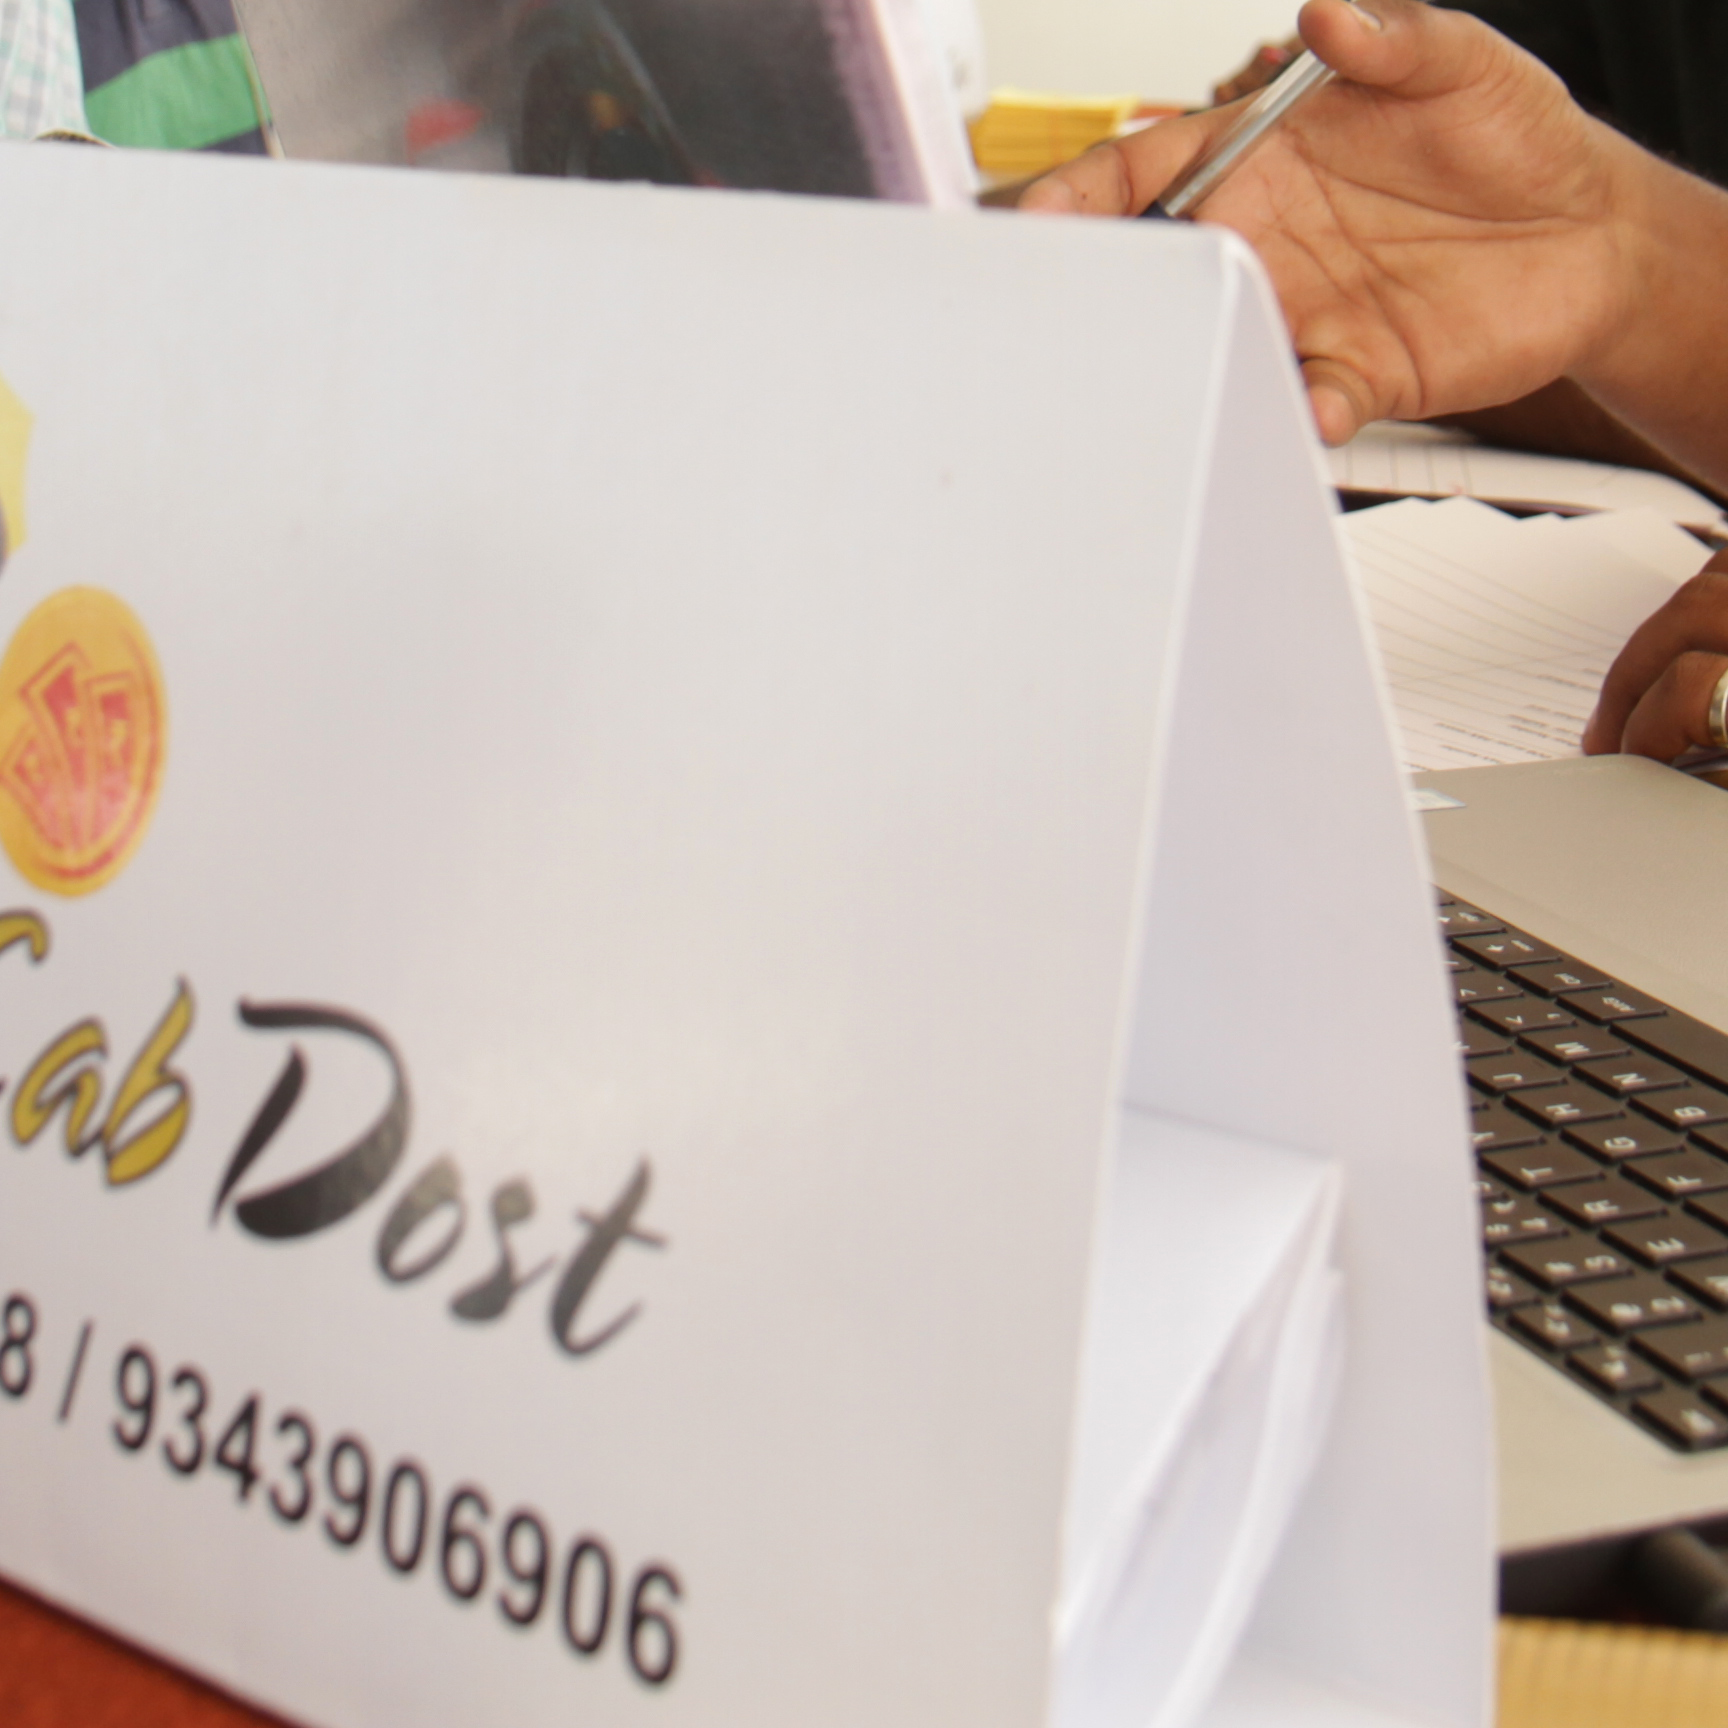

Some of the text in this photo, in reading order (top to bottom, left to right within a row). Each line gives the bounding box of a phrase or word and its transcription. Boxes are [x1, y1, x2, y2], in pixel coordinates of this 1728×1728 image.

[1555, 1041, 1590, 1055] M
[1612, 1073, 1647, 1085] N
[1674, 1106, 1706, 1120] B
[209, 995, 671, 1357] Dost
[1545, 1103, 1581, 1117] H
[1604, 1137, 1637, 1152] G
[1667, 1176, 1702, 1190] F
[1521, 1167, 1553, 1181] T
[1647, 1238, 1685, 1255] E
[57, 1319, 93, 1422] /
[112, 1342, 684, 1688] 9343906906
